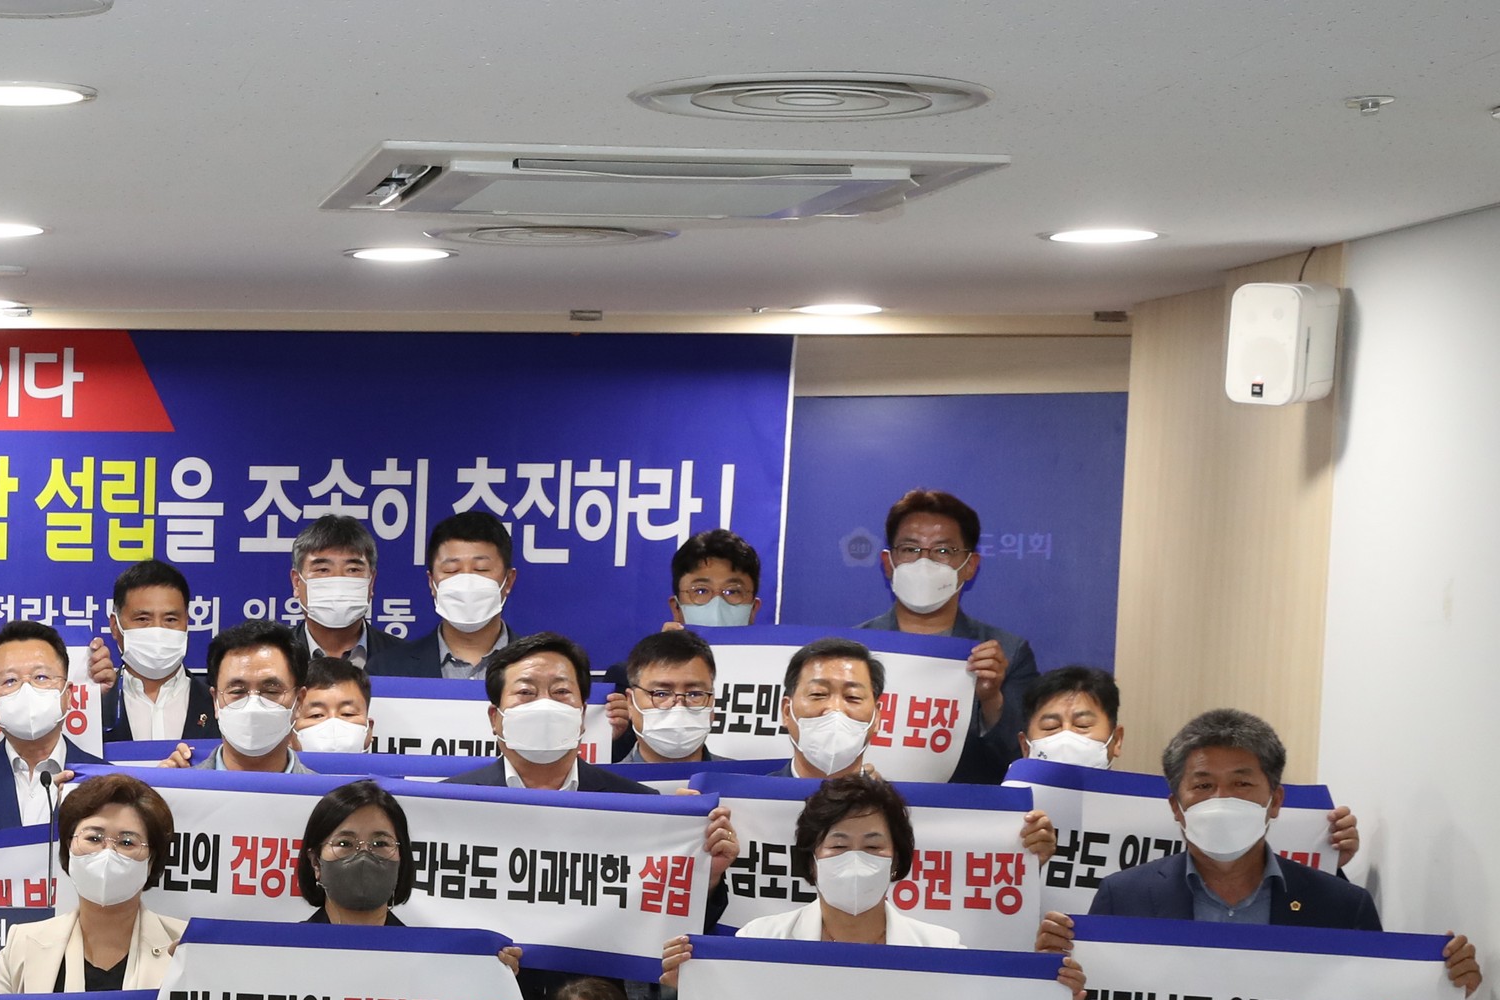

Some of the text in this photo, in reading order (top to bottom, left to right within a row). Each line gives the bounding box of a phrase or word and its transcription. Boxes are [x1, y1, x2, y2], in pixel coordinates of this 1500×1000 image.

[34, 456, 224, 563] 설립을
[903, 695, 959, 754] 보장
[508, 847, 631, 909] 의과대학
[639, 855, 695, 918] 설립
[964, 851, 1026, 915] 보장
